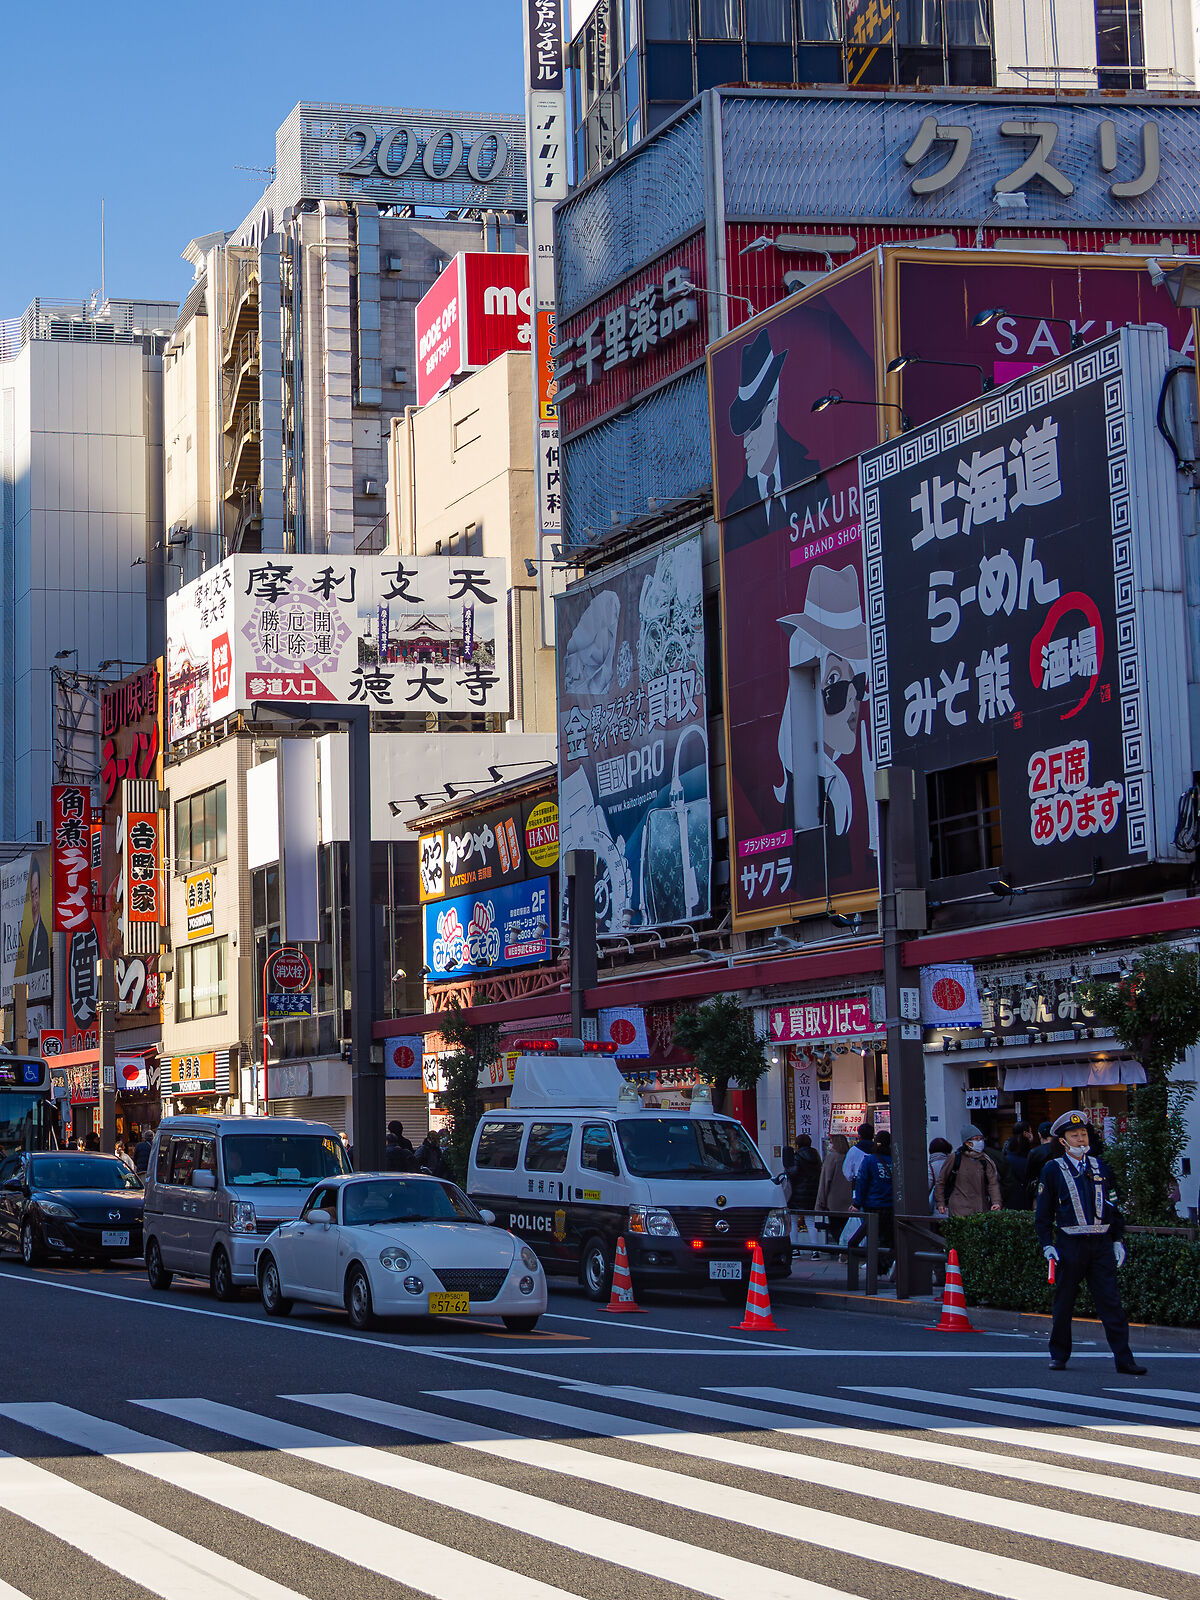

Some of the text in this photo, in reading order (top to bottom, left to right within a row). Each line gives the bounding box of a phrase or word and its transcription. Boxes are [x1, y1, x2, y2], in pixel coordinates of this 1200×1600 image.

[338, 123, 508, 183] 2000
[903, 116, 1161, 198] クスリ
[419, 297, 457, 361] MODE OFF
[911, 415, 1064, 552] 北海道
[803, 538, 835, 561] BRAND
[244, 561, 498, 604] 摩利支天
[927, 537, 1060, 644] らーめん
[261, 610, 280, 655] 勝利
[287, 610, 306, 655] 厄除
[313, 610, 332, 655] 開運
[1040, 626, 1100, 691] 酒場
[249, 677, 317, 696] 参道入口
[347, 664, 500, 706] 徳大寺
[647, 668, 699, 732] 買取
[903, 643, 1016, 738] みそ熊
[563, 705, 591, 762] 金
[1030, 745, 1088, 794] 2F席
[1032, 785, 1122, 841] あります
[55, 787, 90, 930] 角煮ラーメン
[446, 823, 495, 875] かつや
[743, 831, 788, 853] ブランドショップ
[129, 820, 157, 914] 吉野家
[450, 870, 477, 888] KATSUYA
[740, 857, 794, 899] サクラ
[188, 878, 212, 909] 吉野家
[532, 889, 546, 914] 2F
[276, 965, 304, 979] 消火栓
[528, 1178, 555, 1194] 警視庁
[509, 1213, 552, 1232] POLICE
[716, 1268, 741, 1278] 70-12
[437, 1301, 468, 1312] 57-62
